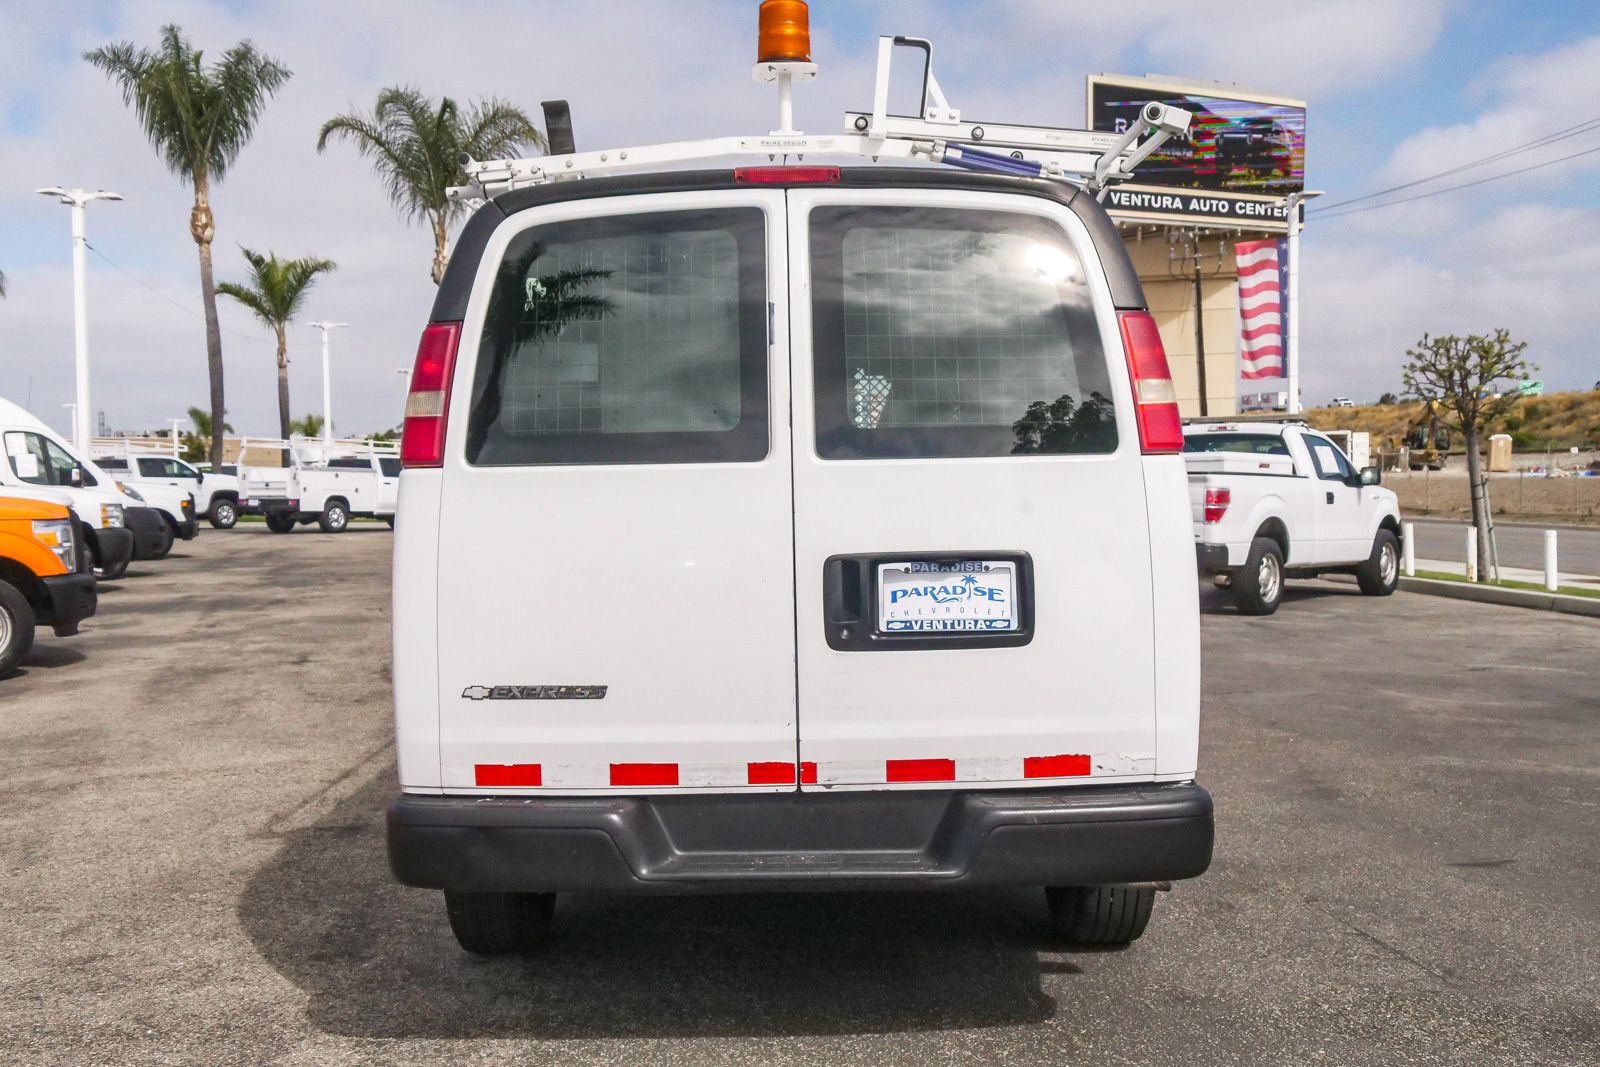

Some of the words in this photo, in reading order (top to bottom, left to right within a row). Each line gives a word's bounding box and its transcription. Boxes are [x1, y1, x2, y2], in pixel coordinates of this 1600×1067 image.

[1110, 192, 1183, 210] VENTURA
[1189, 199, 1229, 213] AUTO
[912, 562, 982, 572] PARADISE
[890, 583, 1005, 604] PARADISE
[890, 606, 1005, 619] CHEVROLET
[911, 619, 987, 630] VENTURA
